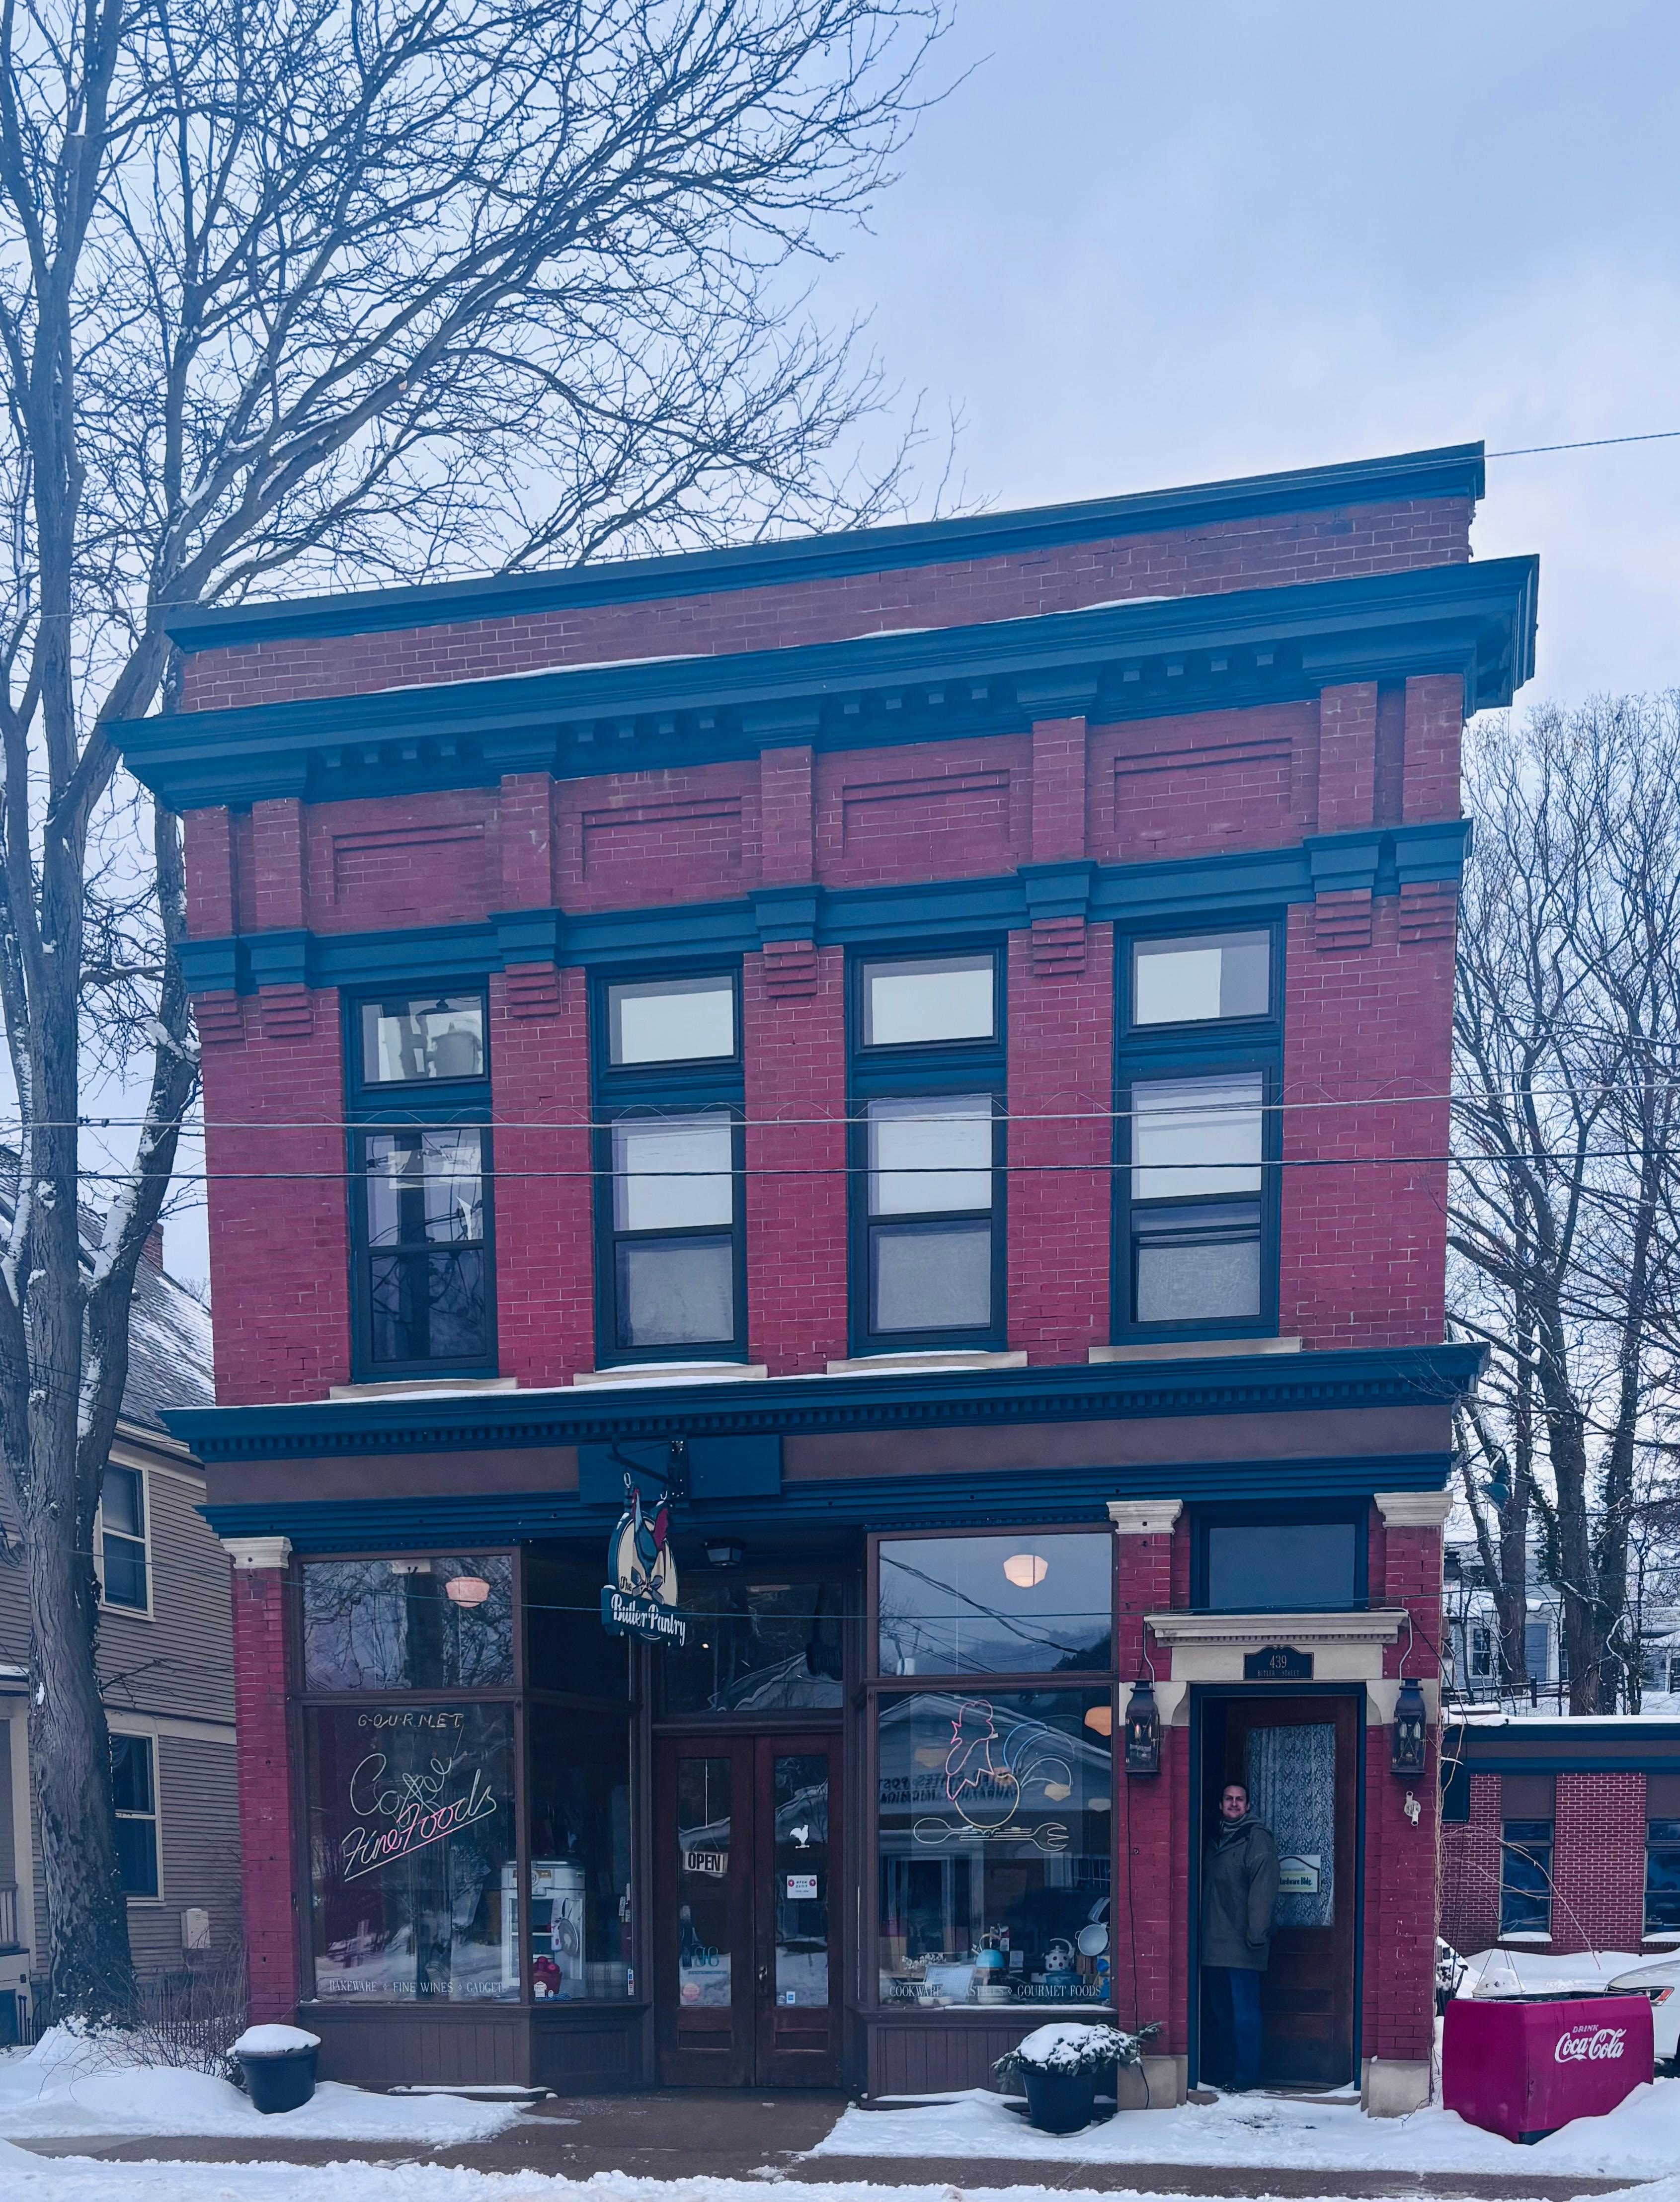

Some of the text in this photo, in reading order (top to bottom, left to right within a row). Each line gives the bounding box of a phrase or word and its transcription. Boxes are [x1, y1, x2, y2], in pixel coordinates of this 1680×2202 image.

[620, 1576, 632, 1592] The
[611, 1593, 686, 1646] Butler Pantry
[1269, 1655, 1287, 1669] 439
[358, 1713, 465, 1728] GOURMET
[341, 1826, 401, 1876] Fine
[688, 1853, 720, 1872] OPEN
[329, 1980, 377, 1992] BAKEWARE
[393, 1981, 416, 1993] FINE
[420, 1981, 454, 1993] WINES
[889, 1985, 942, 1997] COOKWARE
[1017, 1985, 1067, 1997] GOURMET
[1070, 1985, 1101, 1996] FOODS
[1572, 2024, 1599, 2034] DRINK
[1554, 2028, 1627, 2063] Coca-Cola
